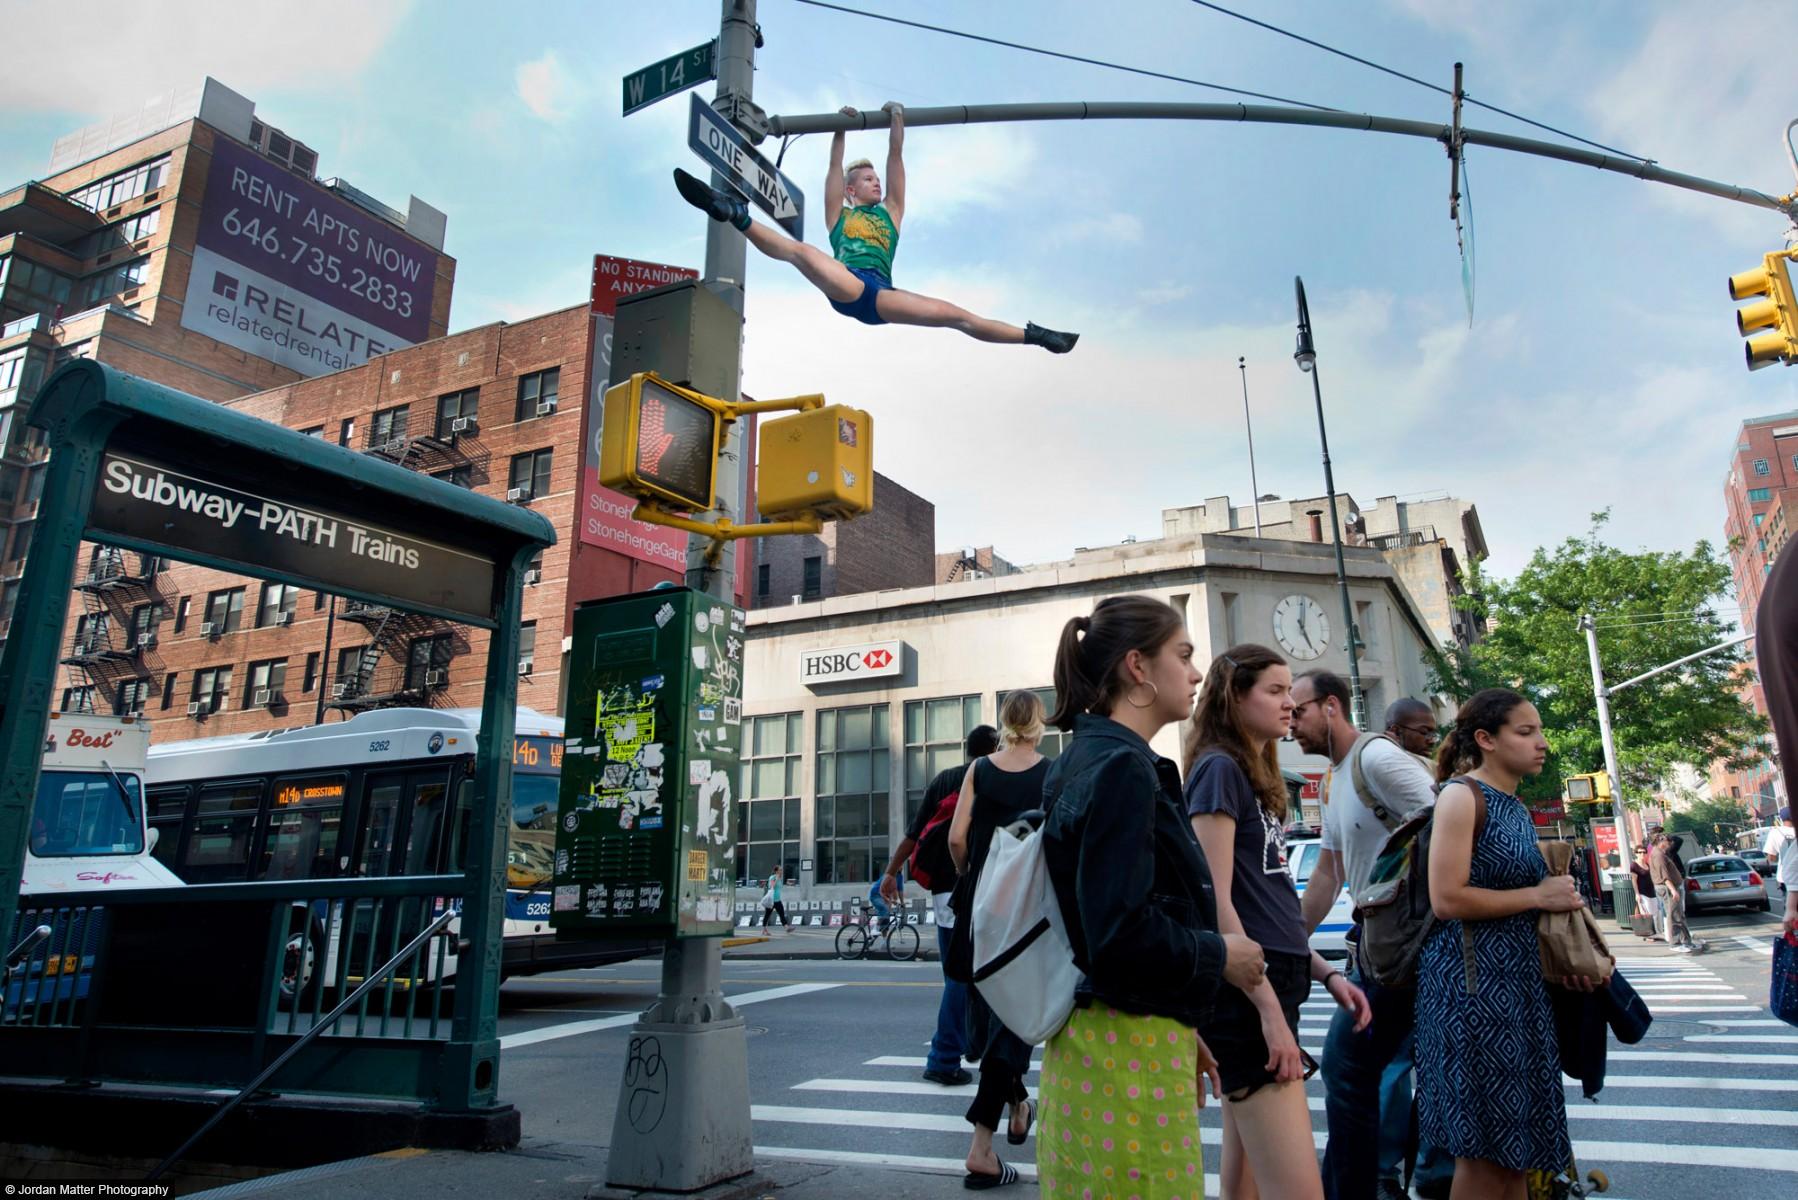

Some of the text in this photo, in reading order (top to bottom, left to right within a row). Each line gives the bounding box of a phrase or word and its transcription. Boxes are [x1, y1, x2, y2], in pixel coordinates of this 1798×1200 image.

[629, 48, 709, 107] W 14 ST
[709, 127, 789, 211] ONE WAY
[231, 167, 421, 283] RENT APTS NOW
[222, 207, 413, 318] 646.735.2833
[601, 261, 620, 275] NO
[244, 284, 395, 358] RELATE
[347, 525, 419, 569] Trains
[806, 652, 860, 676] HSBC
[369, 740, 390, 752] 5262
